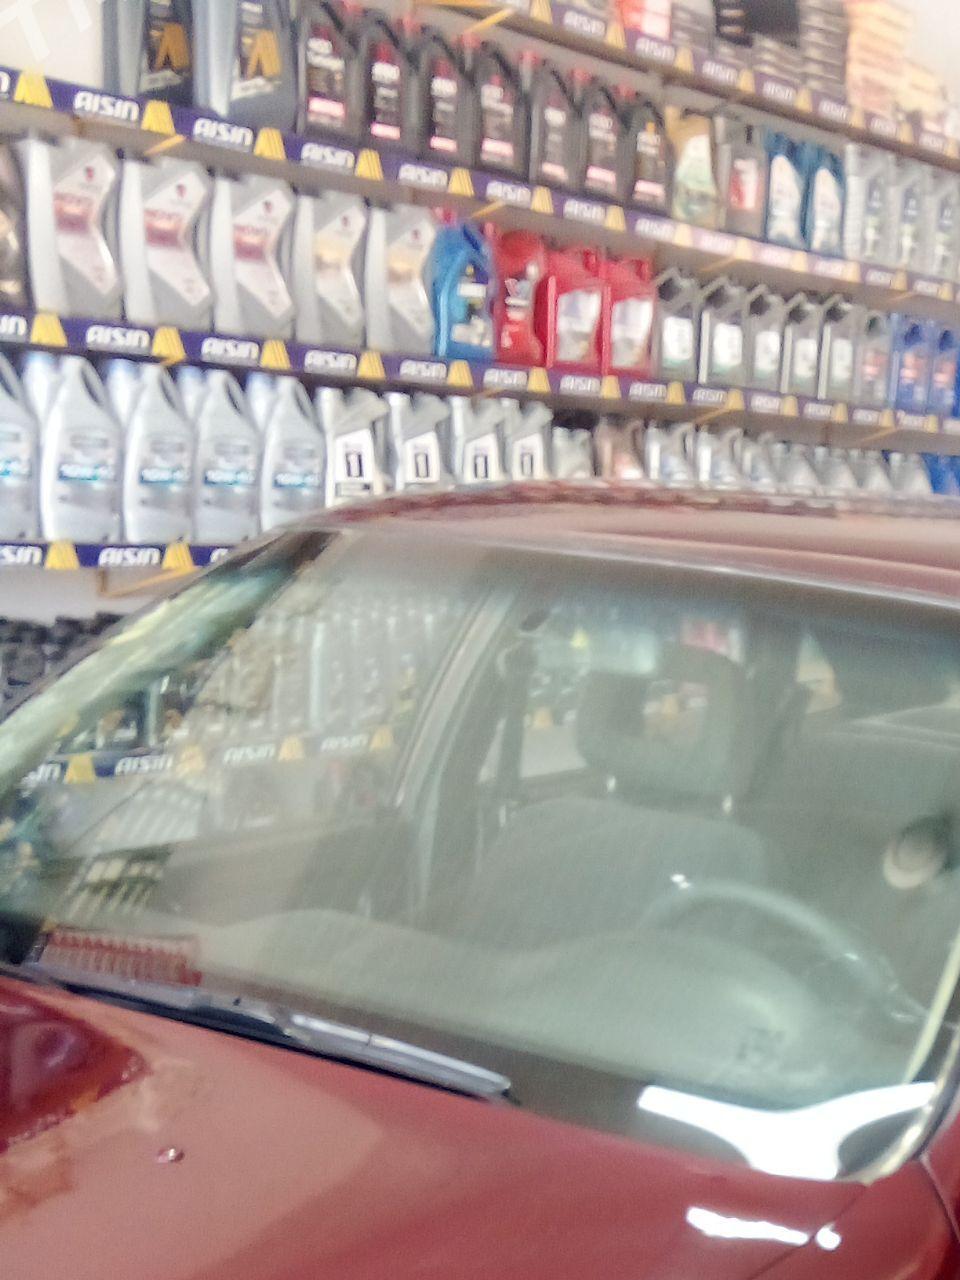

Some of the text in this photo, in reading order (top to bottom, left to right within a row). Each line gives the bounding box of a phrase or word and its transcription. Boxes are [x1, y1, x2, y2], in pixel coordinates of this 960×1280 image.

[73, 91, 140, 121] AISIN
[193, 117, 254, 145] AISIN
[86, 325, 150, 346] AISIN
[201, 338, 260, 359] AISIN
[97, 548, 161, 566] AISIN
